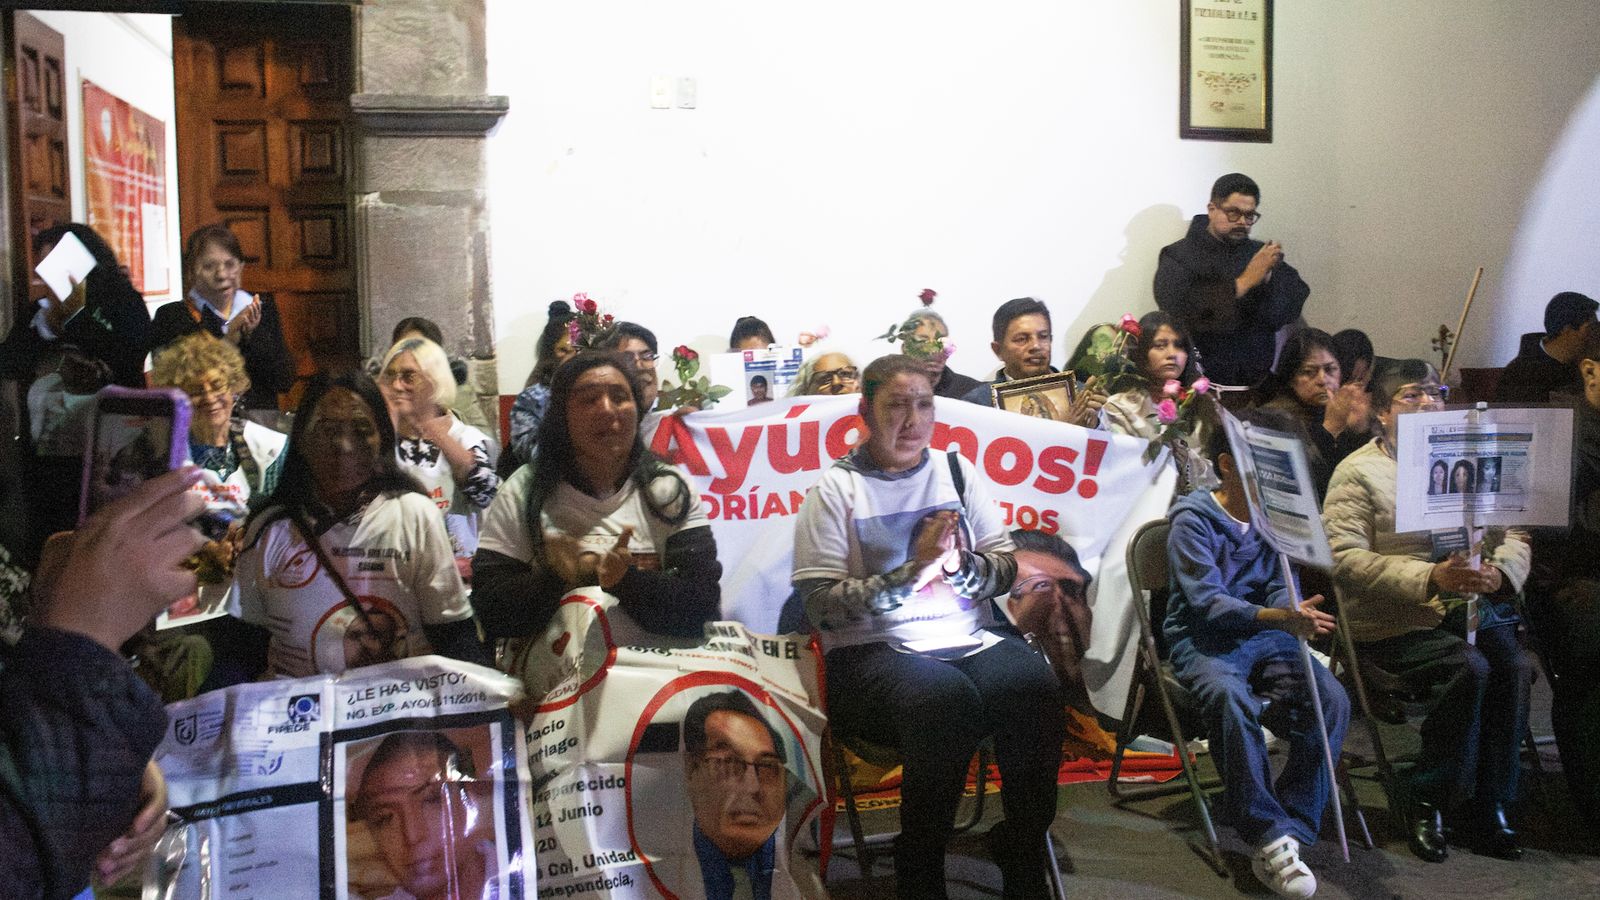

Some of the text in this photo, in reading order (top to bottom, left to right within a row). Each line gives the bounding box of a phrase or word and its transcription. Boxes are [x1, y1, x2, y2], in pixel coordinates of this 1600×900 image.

[993, 499, 1059, 536] JOS
[379, 680, 411, 698] HAS
[346, 710, 368, 721] NO.
[372, 702, 399, 716] EXP.
[558, 802, 603, 823] Junio
[548, 848, 637, 877] Col. Unidad
